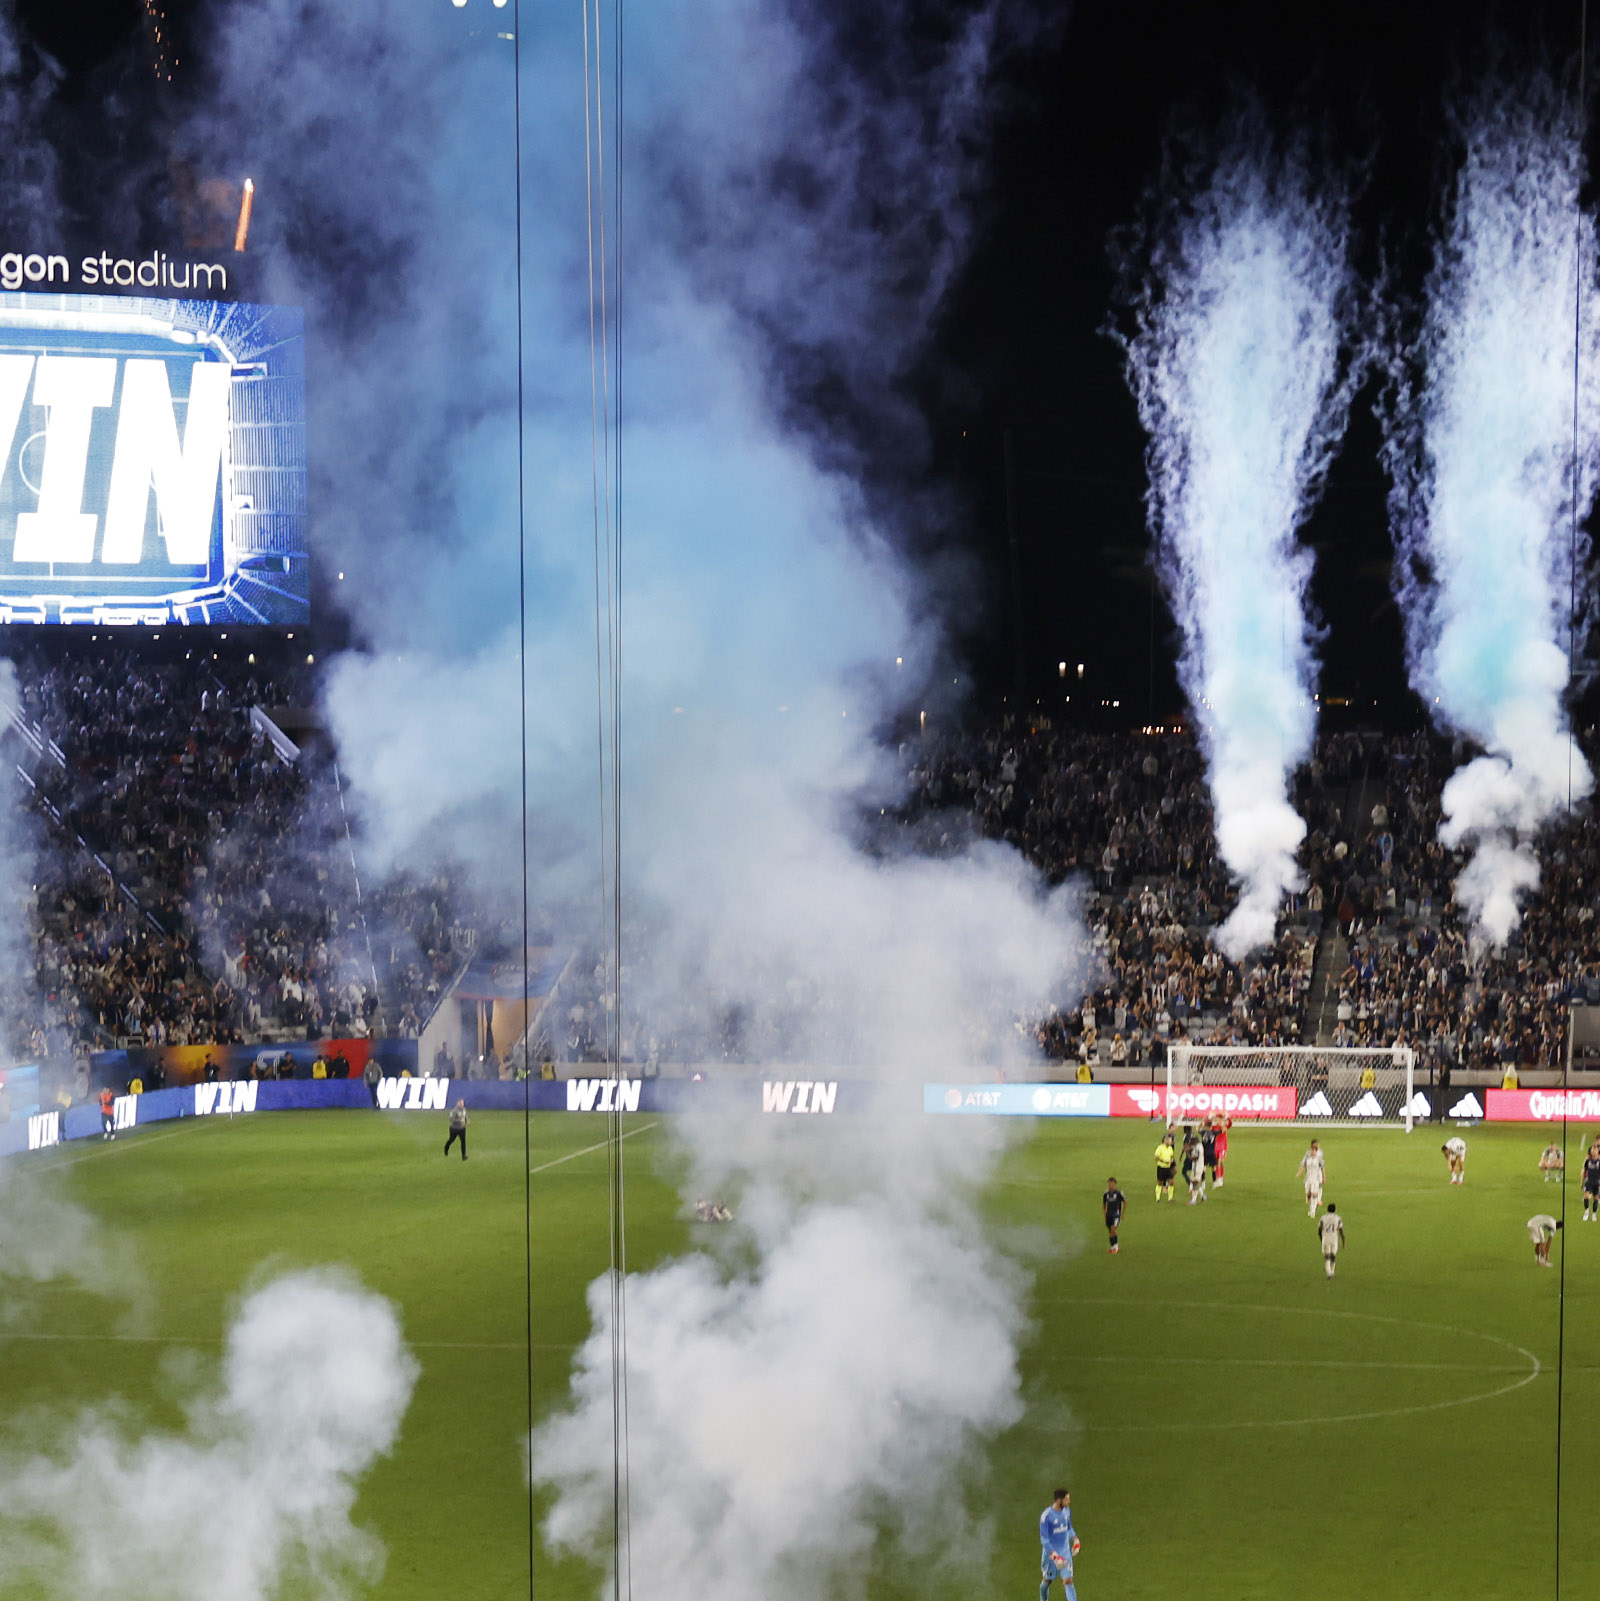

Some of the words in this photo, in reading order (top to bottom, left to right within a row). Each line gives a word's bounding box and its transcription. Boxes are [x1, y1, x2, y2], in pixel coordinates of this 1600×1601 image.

[81, 249, 228, 291] stadium
[195, 1080, 259, 1115] WIN
[377, 1077, 450, 1110] WIN
[566, 1079, 642, 1112] WIN
[763, 1081, 838, 1114] WIN
[965, 1092, 1001, 1107] AT&T
[1053, 1092, 1089, 1107] AT&T
[1165, 1092, 1278, 1111] DOORDASH
[1529, 1091, 1584, 1118] Captain
[28, 1110, 60, 1150] WIN
